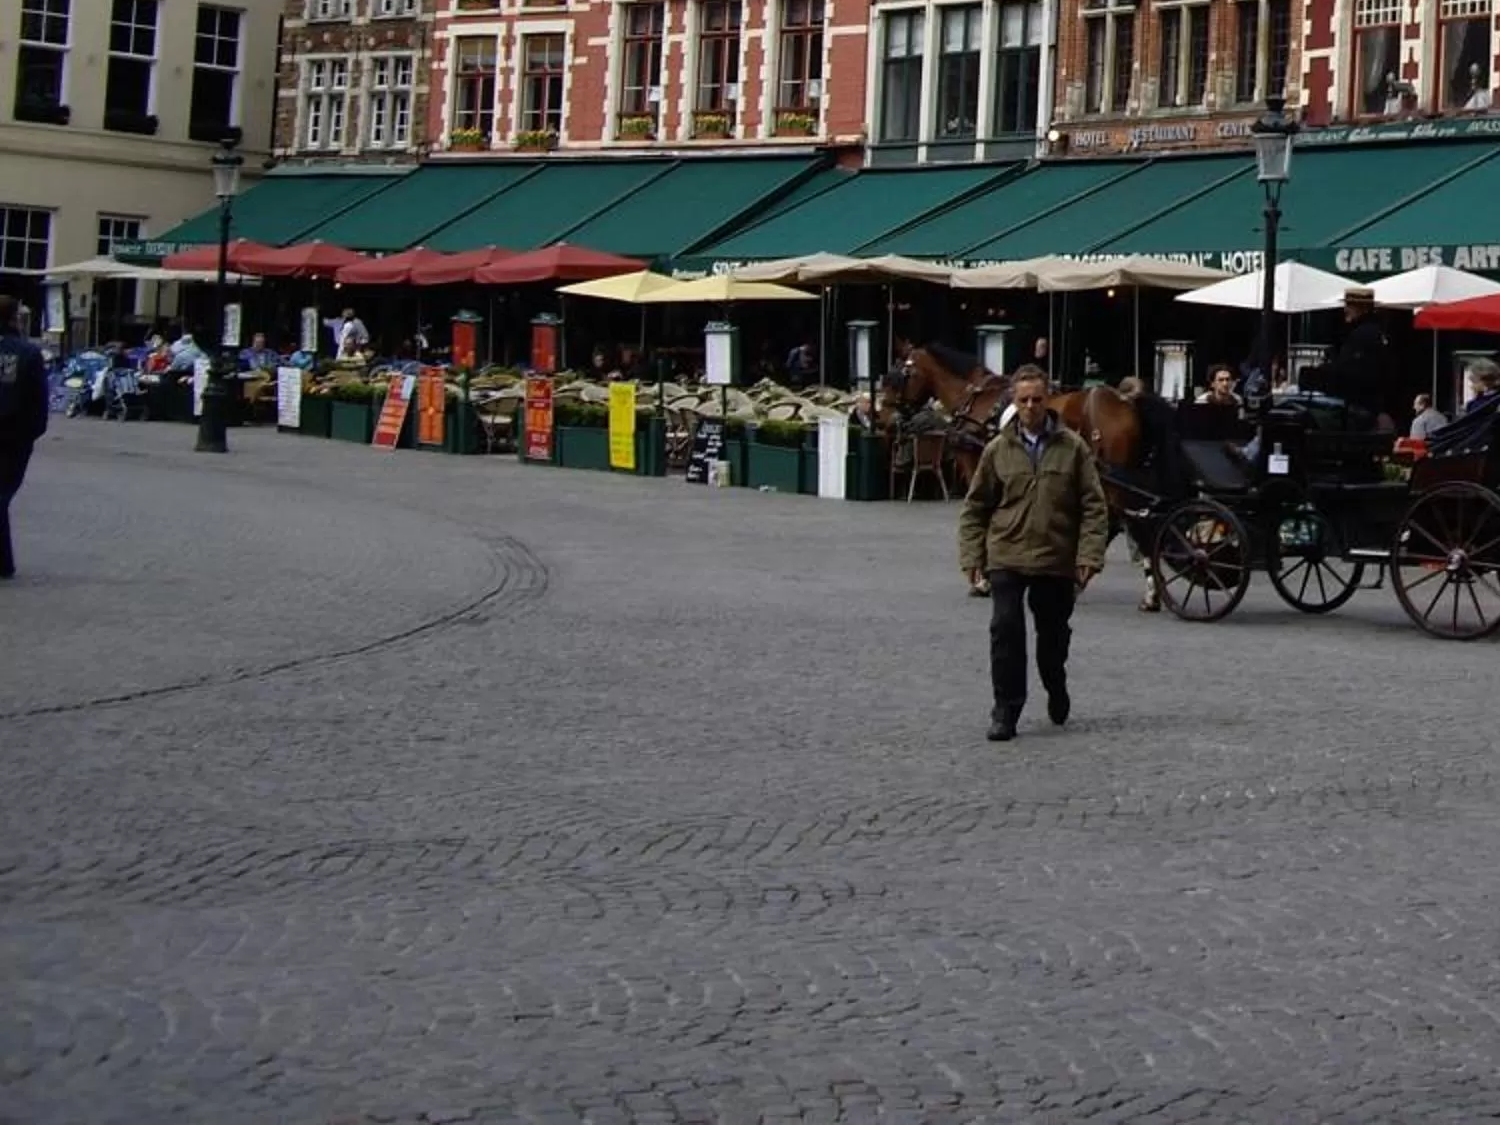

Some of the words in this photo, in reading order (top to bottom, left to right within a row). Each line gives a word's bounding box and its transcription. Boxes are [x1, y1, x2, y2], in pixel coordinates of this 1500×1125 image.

[1075, 130, 1107, 146] HOTEL
[1215, 122, 1252, 139] CENTR
[1336, 247, 1393, 272] CAFE
[1402, 246, 1444, 270] DES
